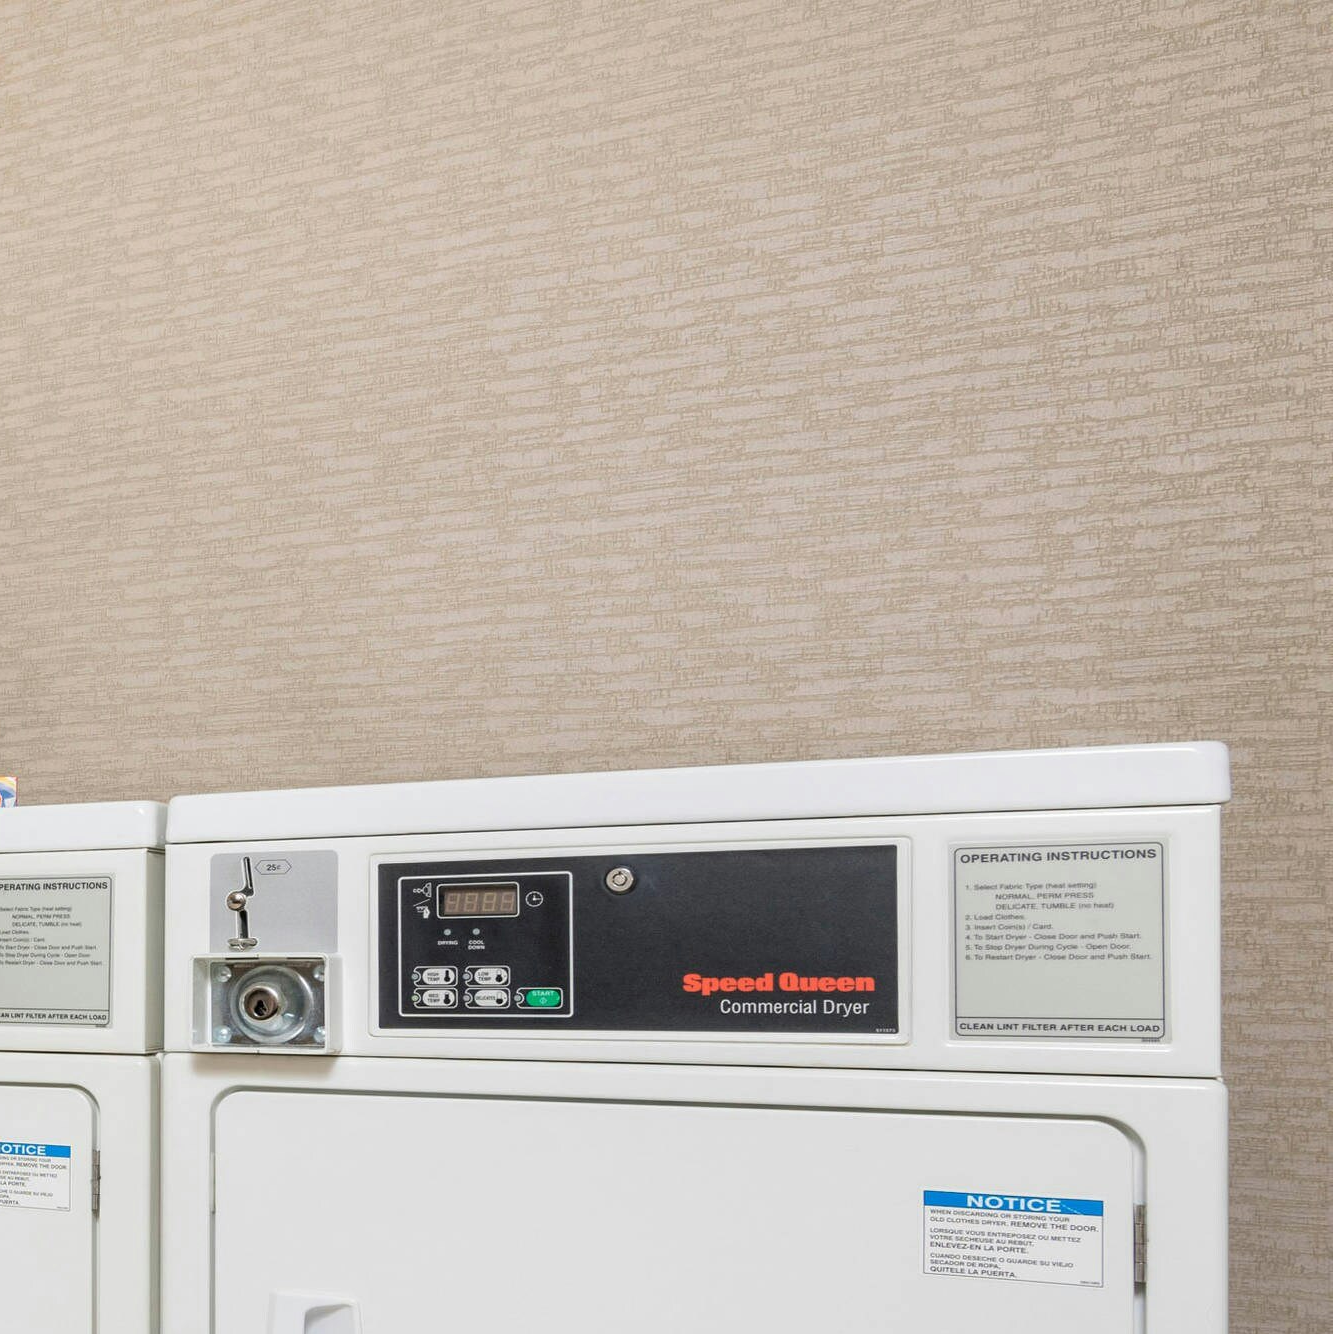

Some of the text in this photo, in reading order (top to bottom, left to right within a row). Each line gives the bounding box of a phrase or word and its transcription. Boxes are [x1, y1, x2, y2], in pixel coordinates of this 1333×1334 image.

[960, 849, 1157, 864] OPERATING INSTRUCTIONS
[43, 882, 108, 890] INSTRUCTIONS
[683, 972, 875, 996] Speed Queen
[720, 999, 869, 1017] Commercial Dryer
[959, 1023, 1160, 1032] CLEAN LINT FILTER AFTER EACH LOAD
[967, 1195, 1062, 1212] NOTICE
[1070, 1224, 1099, 1232] DOOR.
[930, 1242, 982, 1250] ENLEVEZ-EN
[997, 1246, 1029, 1254] PORTE.
[930, 1266, 965, 1274] QUITELE
[981, 1270, 1017, 1278] PUERTA.
